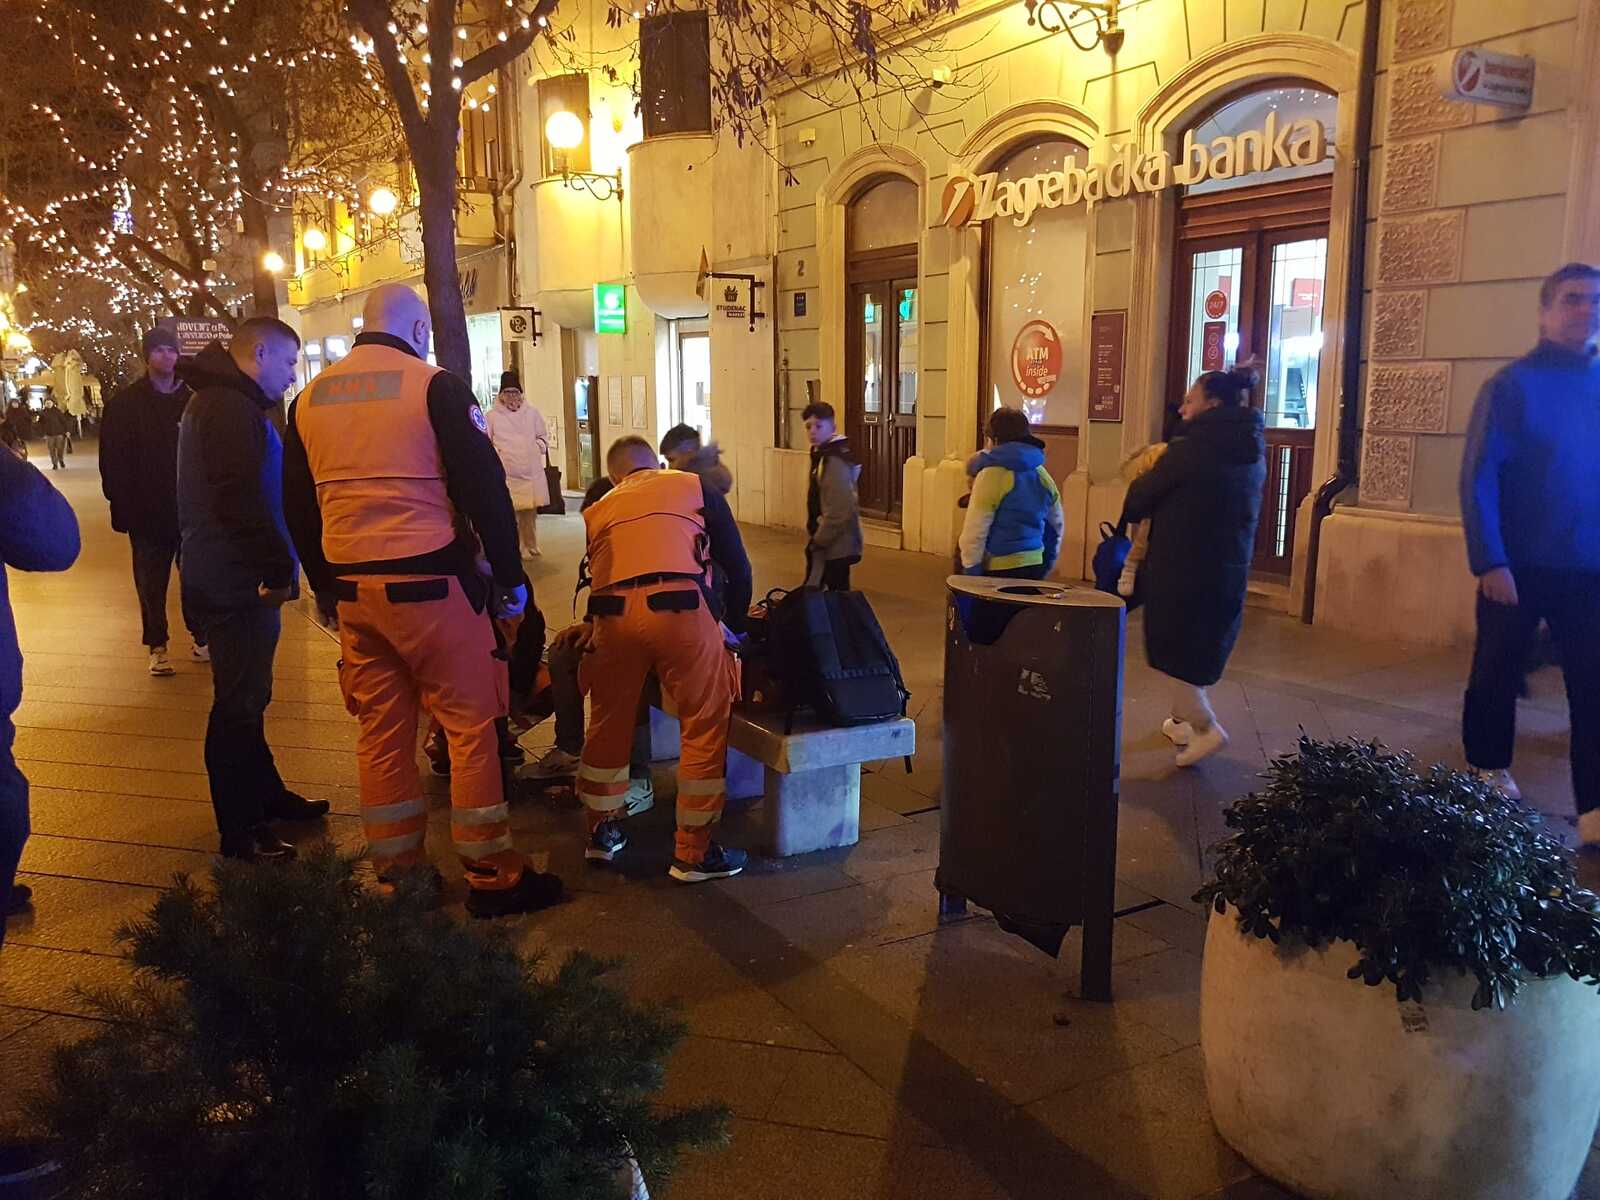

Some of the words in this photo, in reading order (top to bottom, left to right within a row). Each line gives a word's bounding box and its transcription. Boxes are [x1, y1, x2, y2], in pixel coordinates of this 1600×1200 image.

[972, 143, 1174, 227] Zagrebačka
[1180, 111, 1326, 185] banka
[798, 260, 805, 276] 2
[1026, 347, 1049, 360] ATM
[1026, 365, 1048, 376] inside
